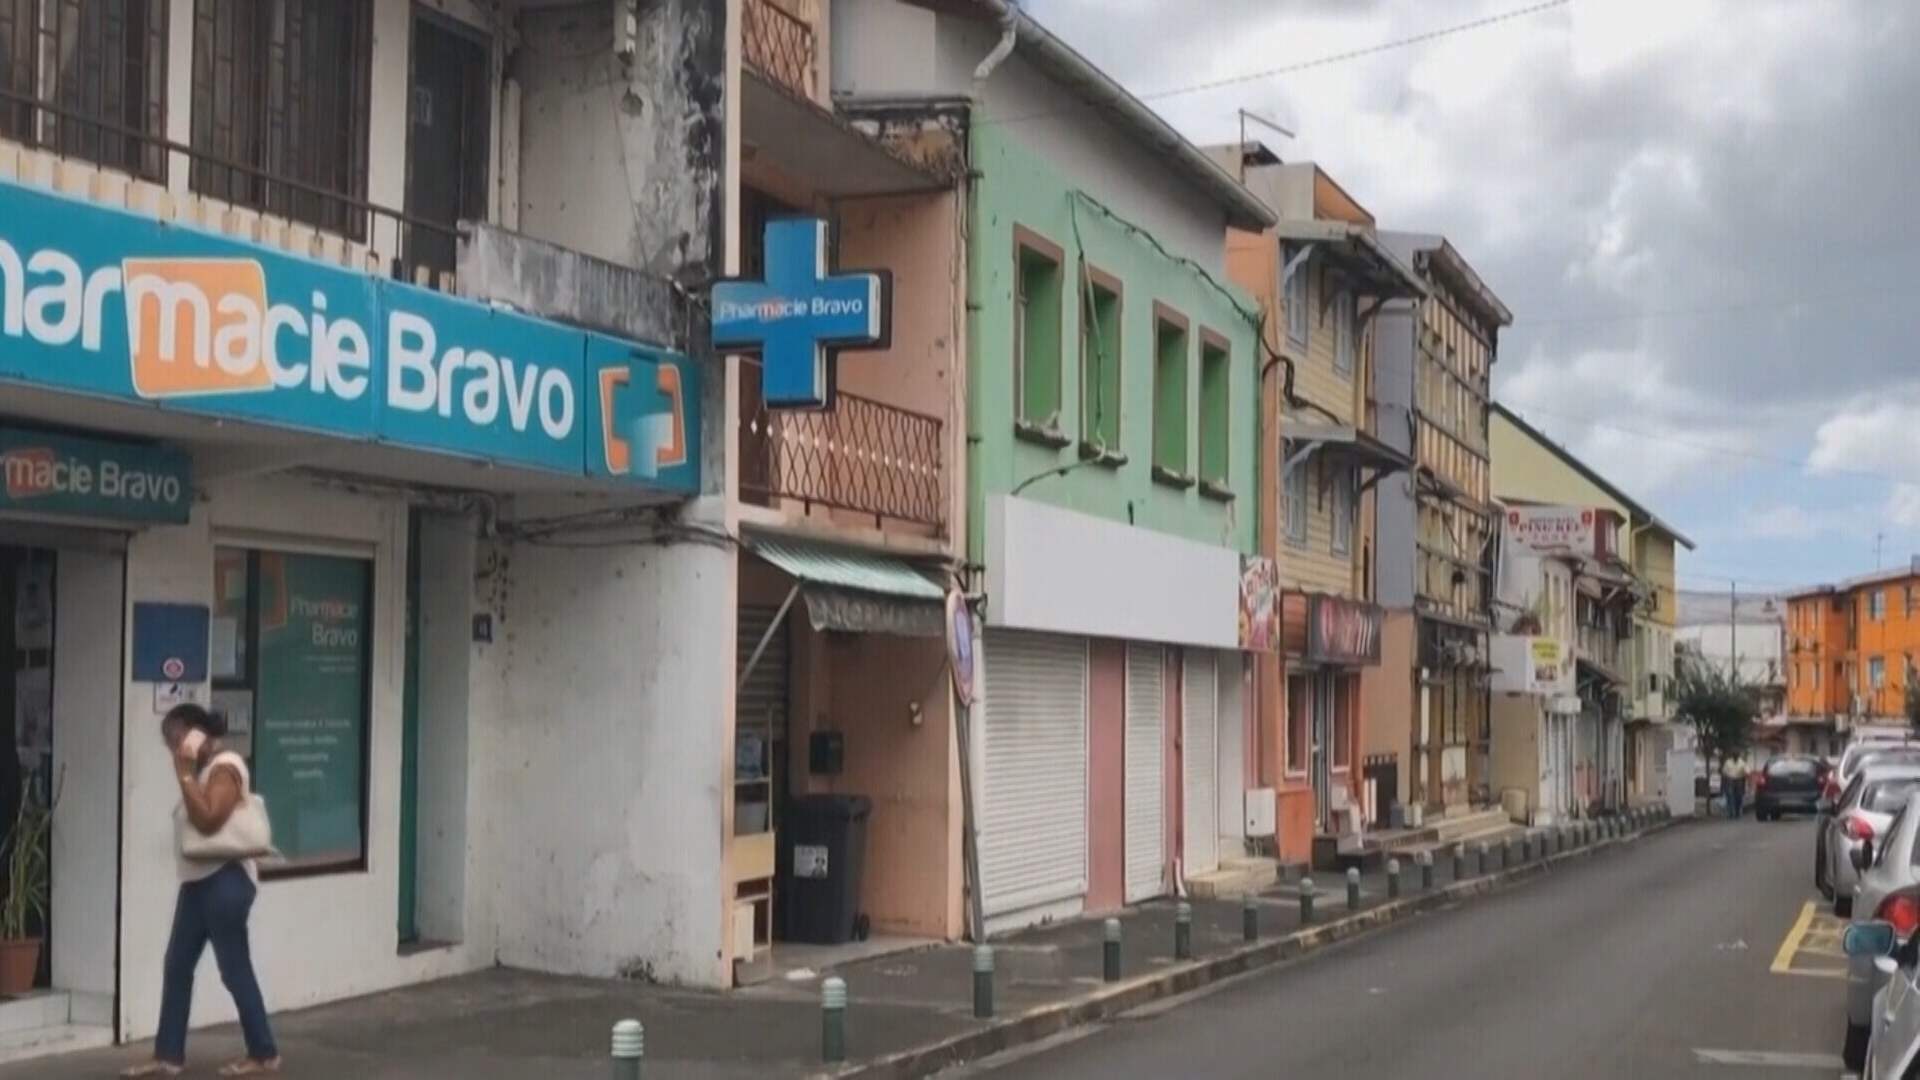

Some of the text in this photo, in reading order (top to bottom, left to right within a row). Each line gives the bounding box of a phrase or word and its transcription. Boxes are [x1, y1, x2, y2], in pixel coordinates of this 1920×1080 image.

[719, 297, 863, 320] Pharmacie Bravo
[387, 311, 575, 440] Bravo
[0, 456, 181, 503] macie Bravo
[312, 622, 358, 647] Bravo
